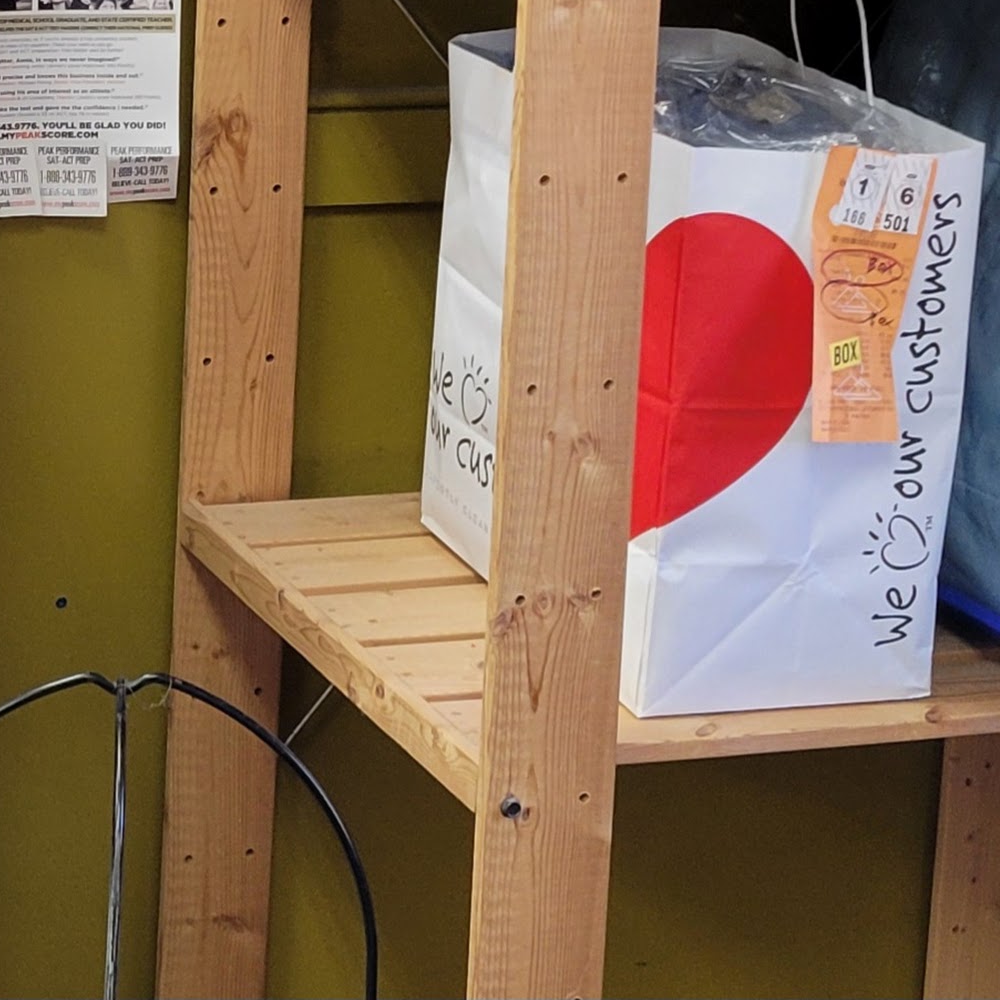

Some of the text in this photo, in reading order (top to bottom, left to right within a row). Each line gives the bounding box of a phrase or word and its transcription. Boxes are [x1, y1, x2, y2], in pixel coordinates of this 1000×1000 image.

[42, 122, 76, 130] YOU'LL
[80, 122, 92, 130] BE
[94, 122, 121, 130] GLAD
[123, 122, 144, 130] YOU
[38, 146, 100, 155] PEAK PERFORMANCE
[6, 157, 20, 165] PREP
[859, 178, 914, 206] 1 6
[883, 213, 910, 232] 501
[833, 340, 859, 366] BOX
[872, 193, 961, 647] We our customers
